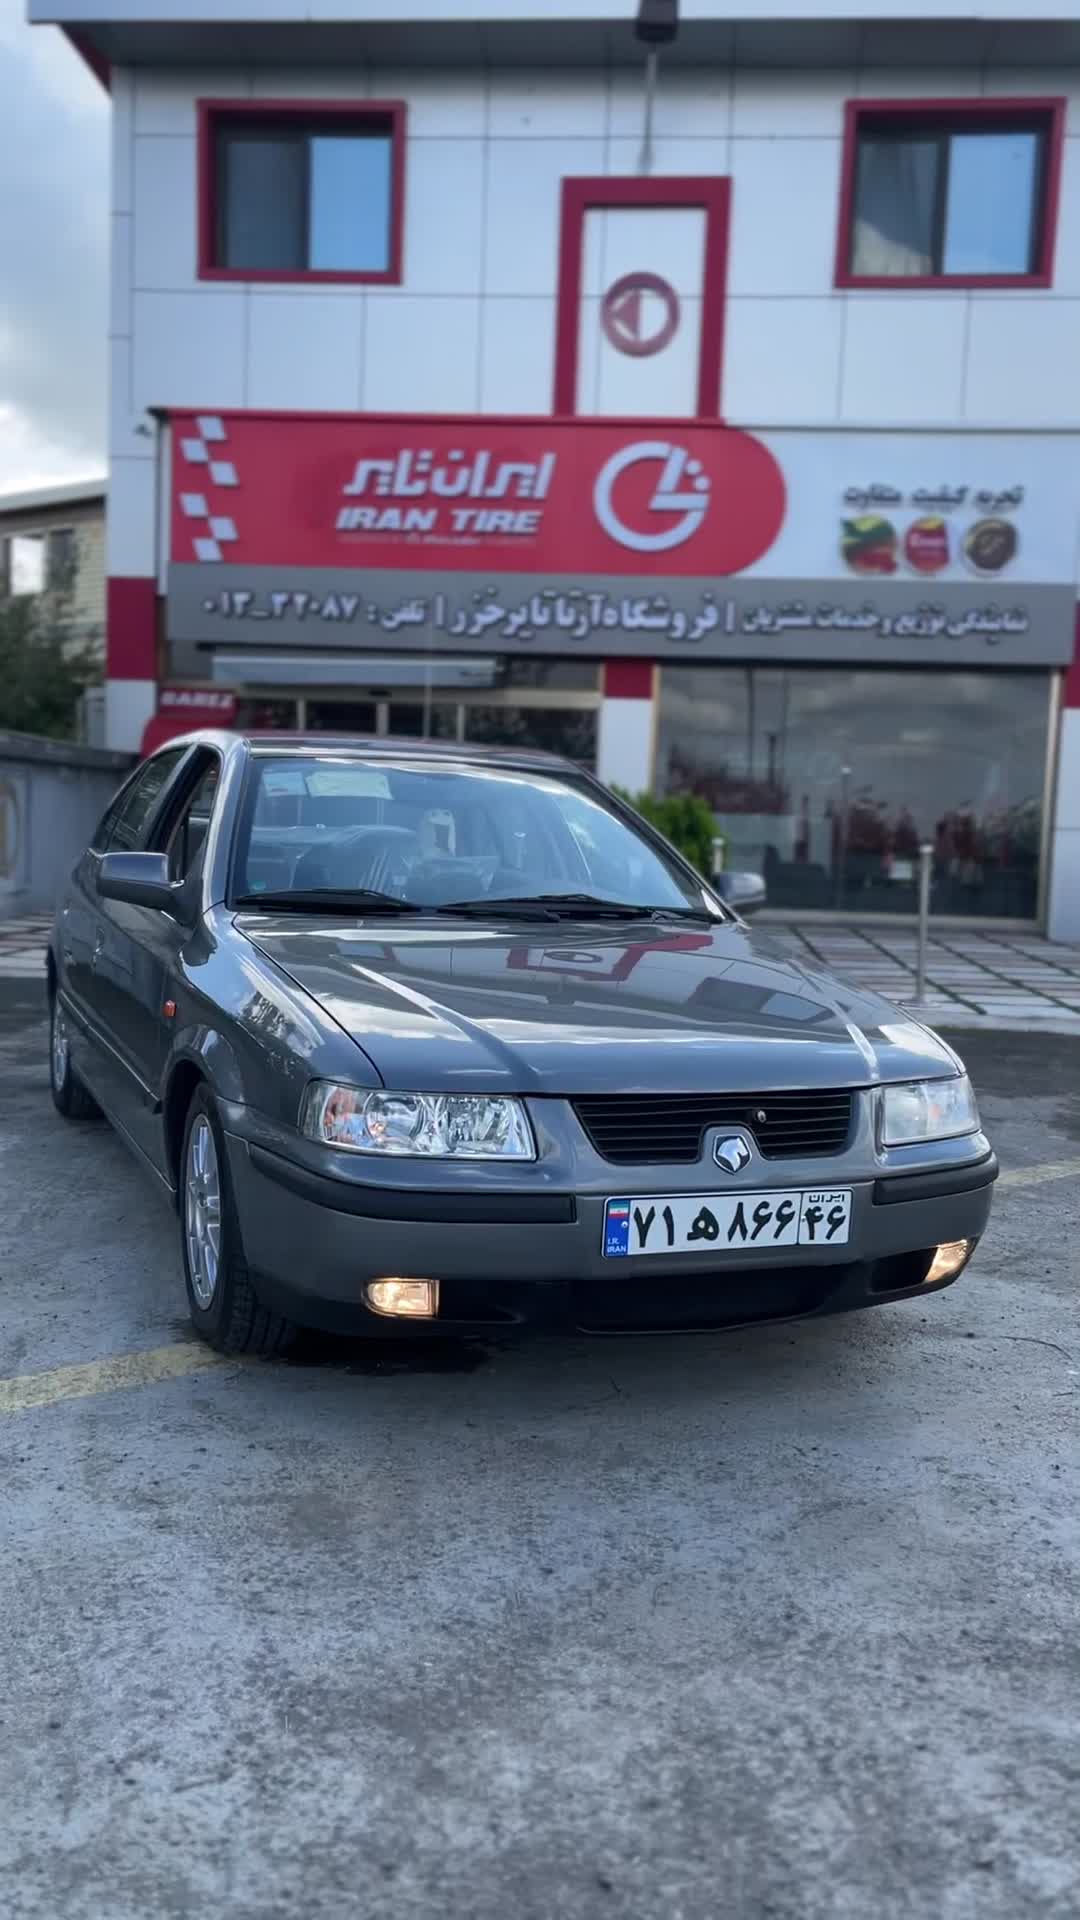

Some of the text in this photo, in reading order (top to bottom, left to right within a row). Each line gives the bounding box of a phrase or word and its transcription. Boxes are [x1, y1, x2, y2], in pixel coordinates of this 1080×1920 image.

[342, 448, 557, 500] ایران تایر
[335, 506, 543, 533] IRAN TIRE
[603, 592, 719, 639] فروشگاه
[808, 1193, 845, 1203] ایران
[804, 1205, 846, 1241] ۴۶
